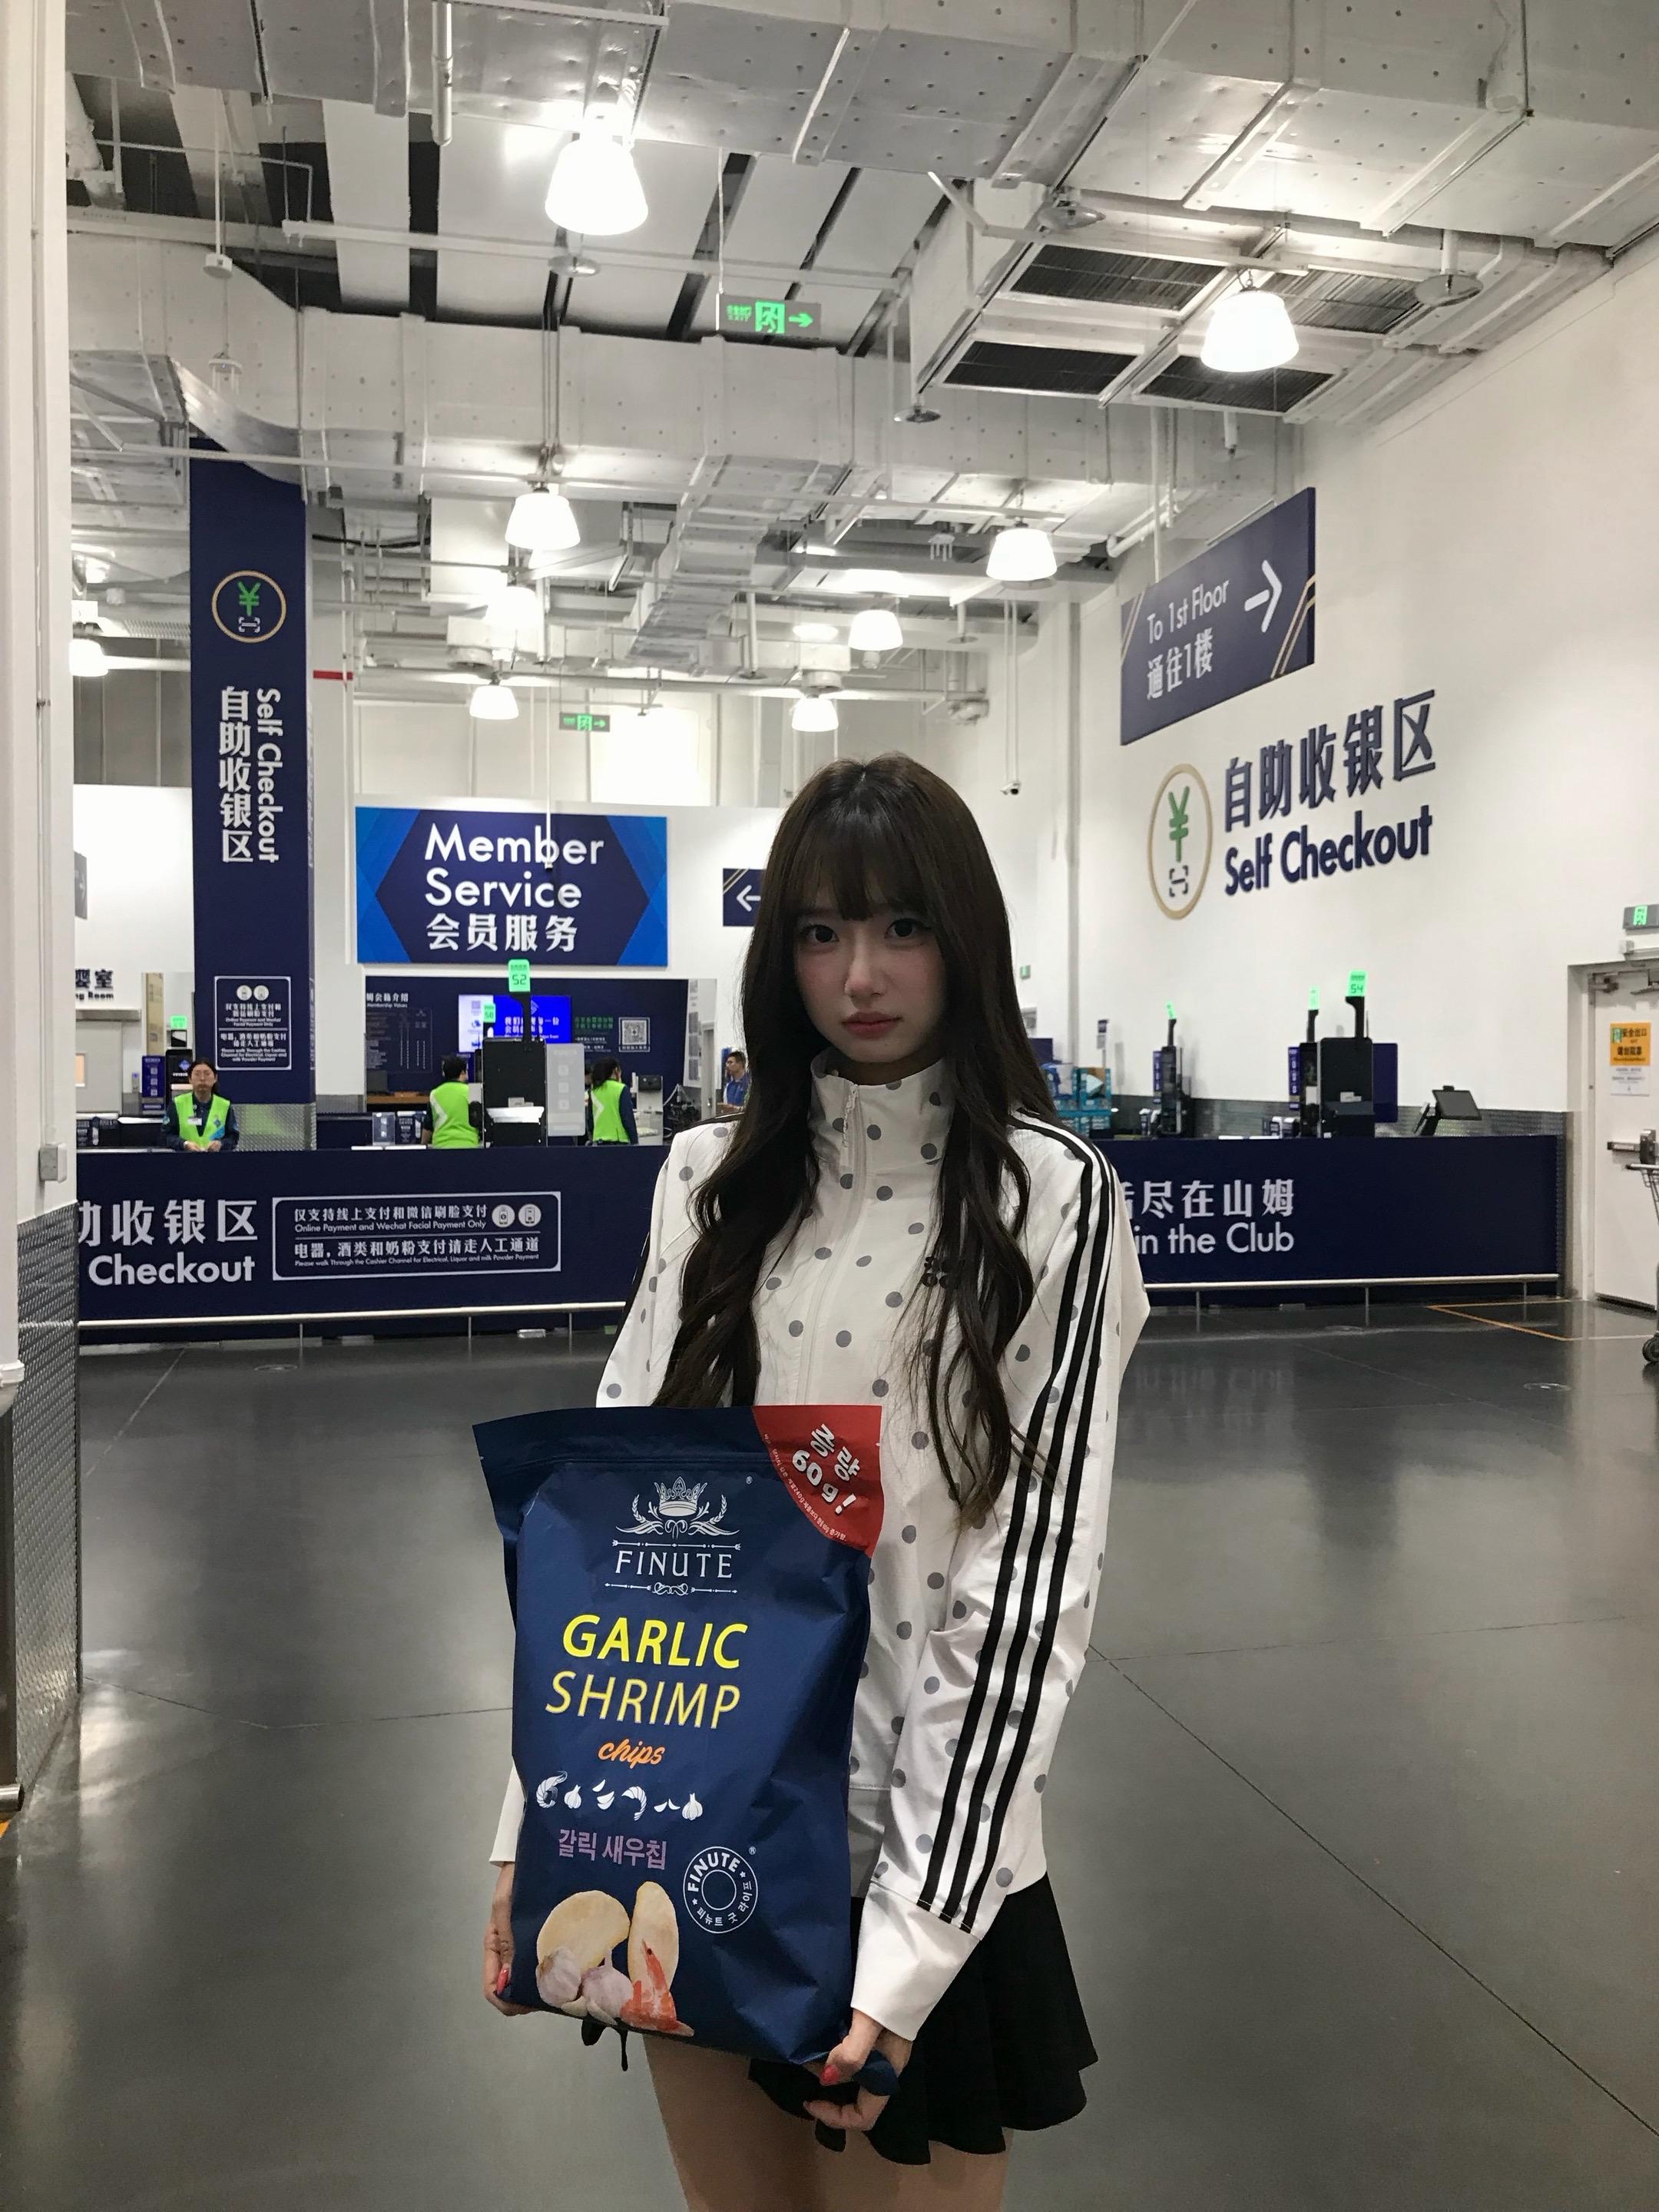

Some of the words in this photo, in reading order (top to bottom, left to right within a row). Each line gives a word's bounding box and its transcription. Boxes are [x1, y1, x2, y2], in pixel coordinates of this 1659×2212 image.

[1147, 613, 1164, 644] To
[1168, 597, 1188, 633] 1st
[1191, 579, 1229, 619] Floor
[1147, 628, 1214, 700] 通往1楼
[257, 688, 283, 737] Self
[219, 686, 253, 863] 自助收银区
[1225, 689, 1435, 833] 自助收银区
[257, 743, 283, 863] Checkout
[425, 823, 604, 865] Member
[1225, 833, 1273, 896] Self
[1280, 805, 1432, 883] Checkout
[425, 866, 582, 908] Service
[426, 912, 578, 952] 会员服务
[295, 1204, 487, 1222] 仅支持线上支付和微信刷脸支付
[295, 1224, 320, 1233] Online
[323, 1223, 356, 1233] Payment
[359, 1222, 374, 1230] and
[376, 1221, 406, 1230] Wechat
[409, 1220, 431, 1230] Facial
[433, 1220, 465, 1230] Payment
[468, 1219, 487, 1230] Only
[1167, 1223, 1216, 1253] the
[1227, 1221, 1294, 1253] Club
[88, 1252, 255, 1286] Checkout
[810, 1423, 860, 1482] 증량
[615, 1550, 733, 1578] FINUTE
[563, 1614, 748, 1669] GARLIC
[545, 1670, 741, 1729] SHRIMP
[598, 1738, 666, 1769] chips
[558, 1829, 598, 1861] 갈릭
[602, 1835, 667, 1870] 새우칩
[687, 1852, 740, 1892] FINUTE
[697, 1907, 724, 1926] 피뉴트
[737, 1880, 753, 1912] 라이프
